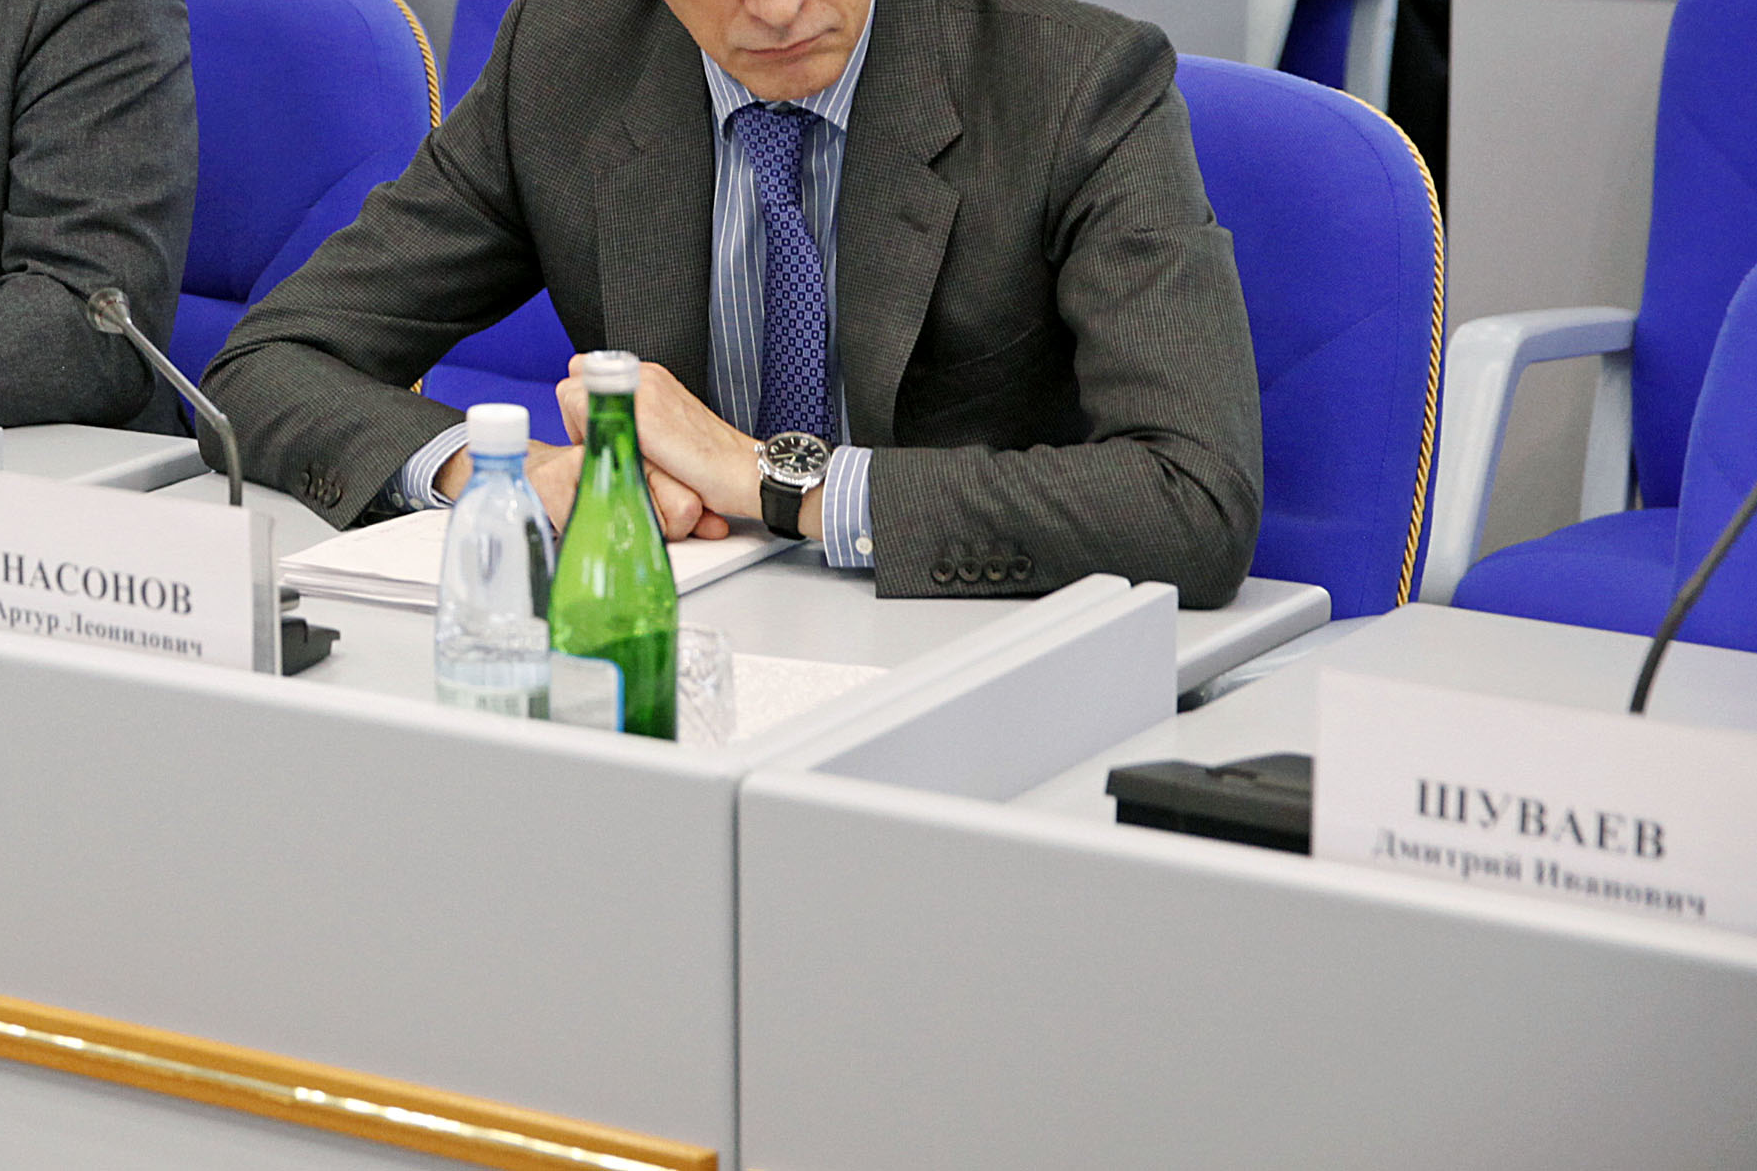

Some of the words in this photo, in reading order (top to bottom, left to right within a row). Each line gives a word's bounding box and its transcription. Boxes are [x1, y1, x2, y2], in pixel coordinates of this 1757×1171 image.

[1, 551, 192, 615] НАСОНОВ
[65, 612, 203, 657] Леонидович
[1417, 779, 1667, 861] ШУВАЕВ
[1374, 830, 1523, 881] Дмитрий
[1534, 857, 1707, 917] Иванович
